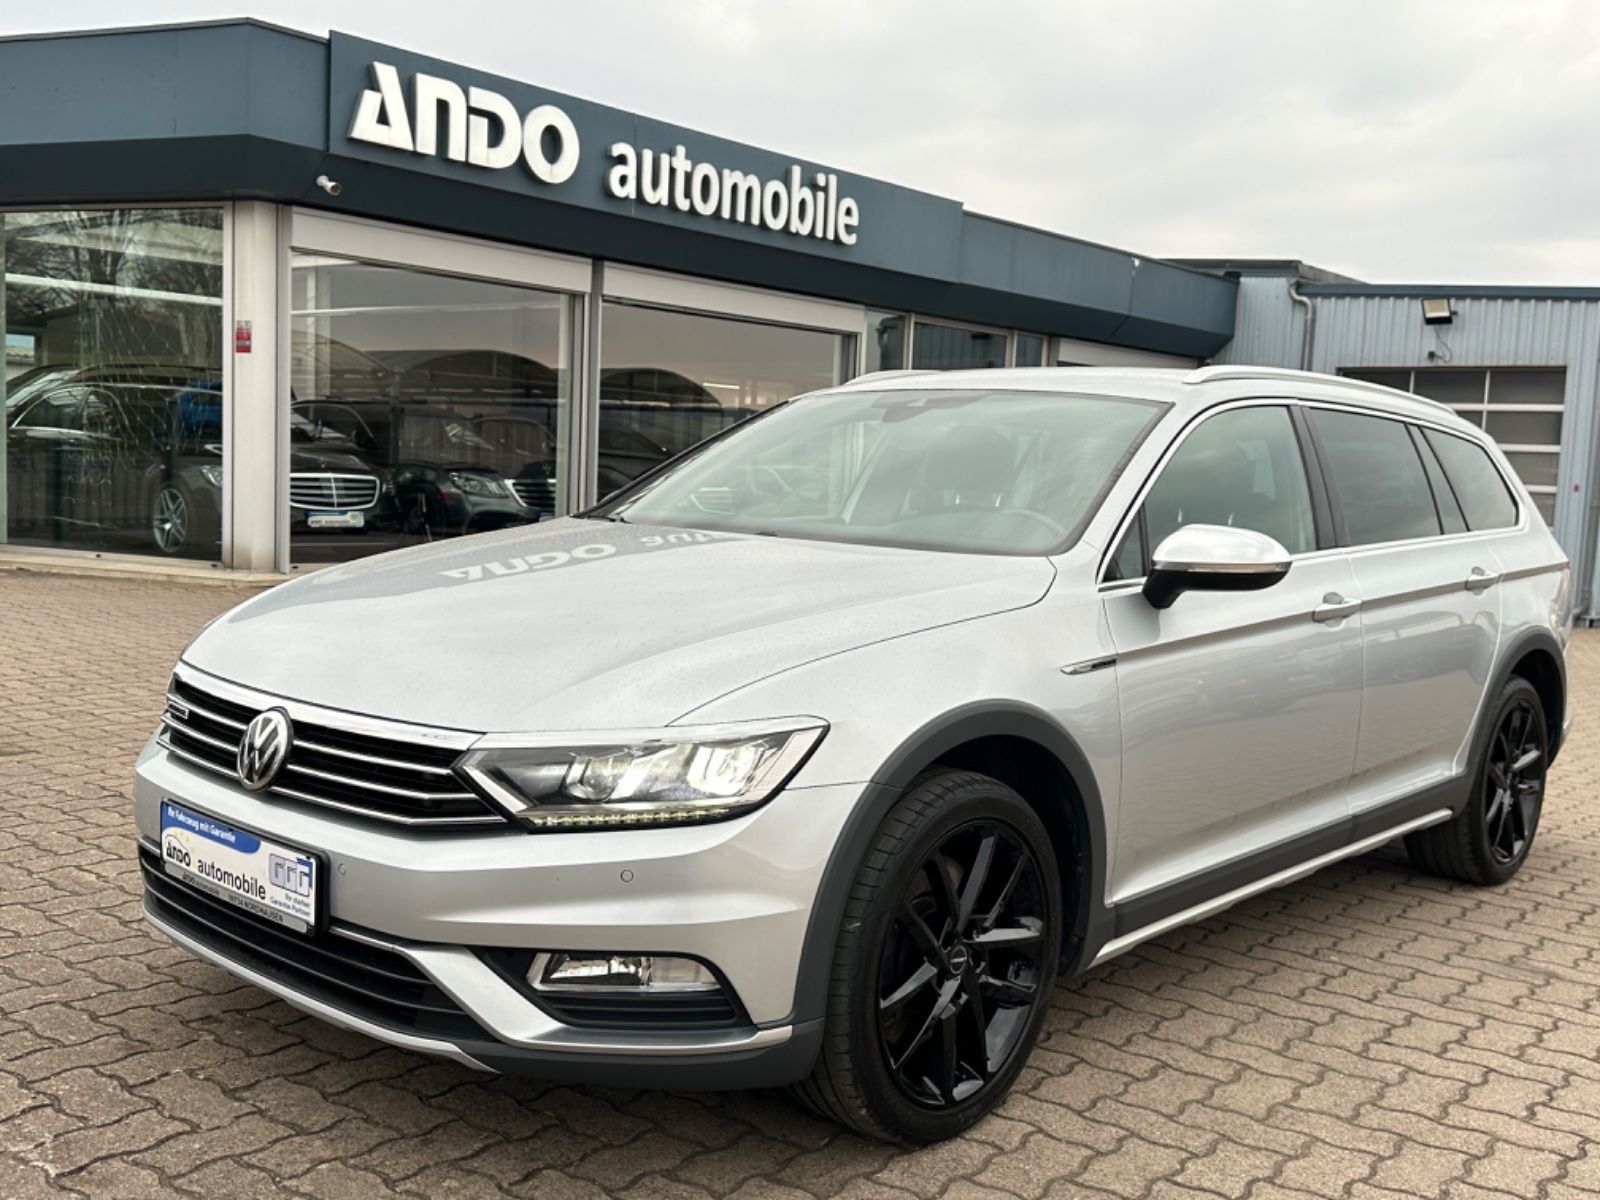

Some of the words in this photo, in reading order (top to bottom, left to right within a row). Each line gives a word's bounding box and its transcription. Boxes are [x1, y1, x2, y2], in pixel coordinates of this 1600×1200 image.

[347, 61, 580, 184] ANDO
[606, 141, 859, 245] automobile
[197, 858, 266, 900] automobile
